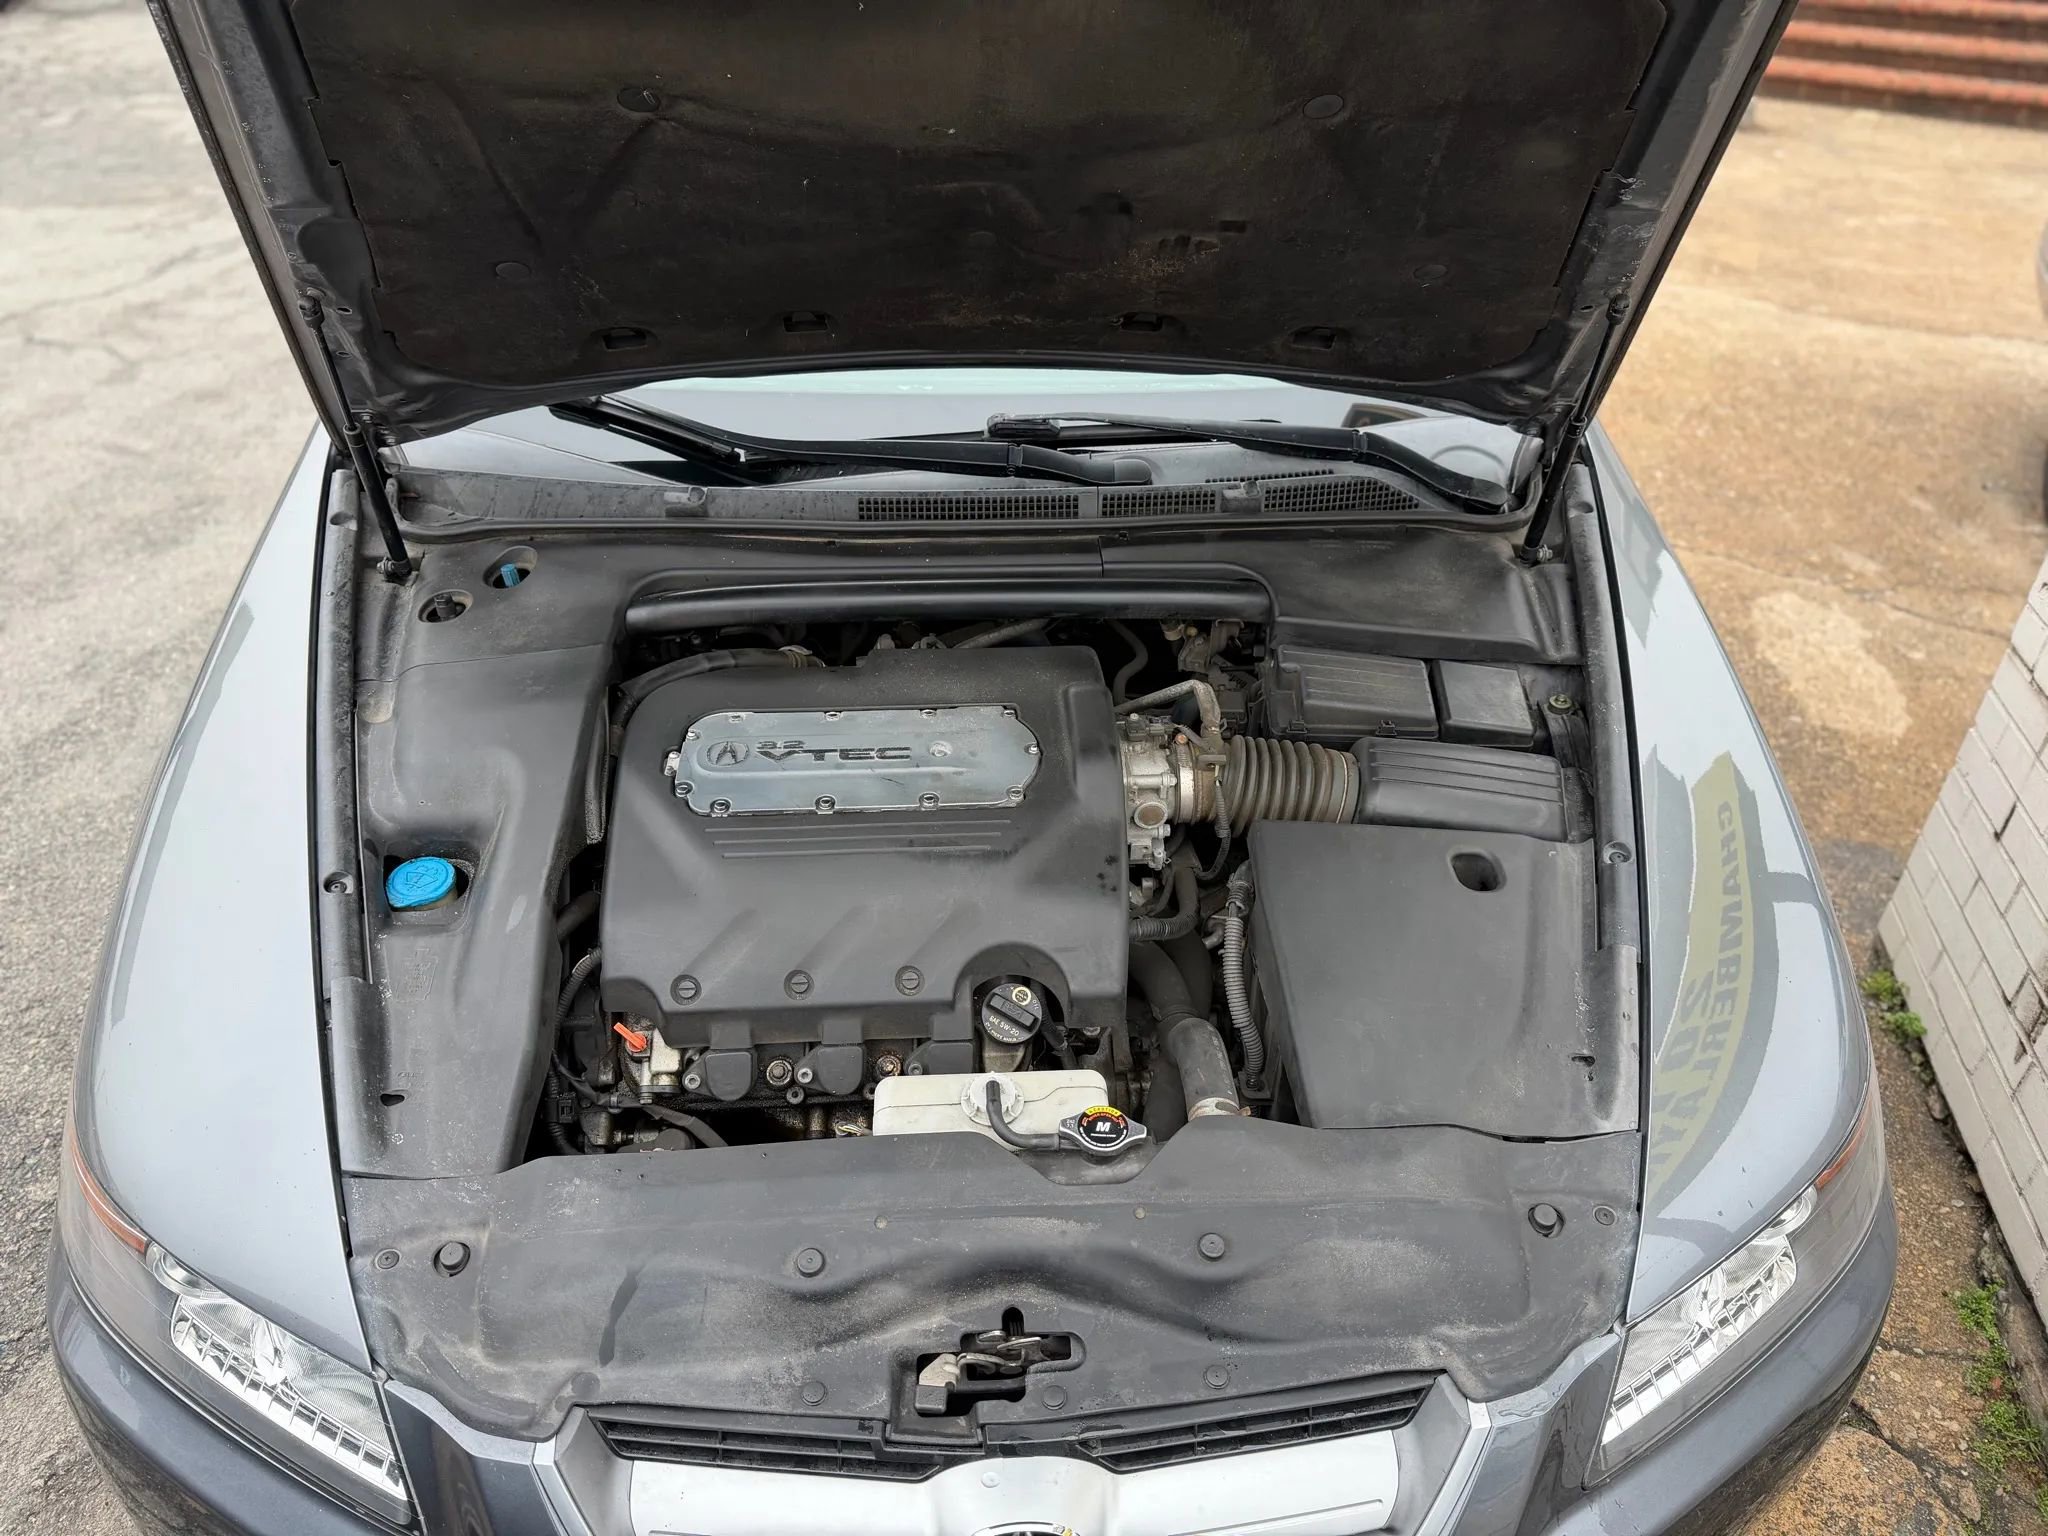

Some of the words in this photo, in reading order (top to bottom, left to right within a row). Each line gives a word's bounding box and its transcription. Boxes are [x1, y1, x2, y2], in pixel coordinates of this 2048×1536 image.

[757, 740, 806, 749] 3.2
[756, 747, 911, 761] VTEC
[1096, 1121, 1111, 1132] M
